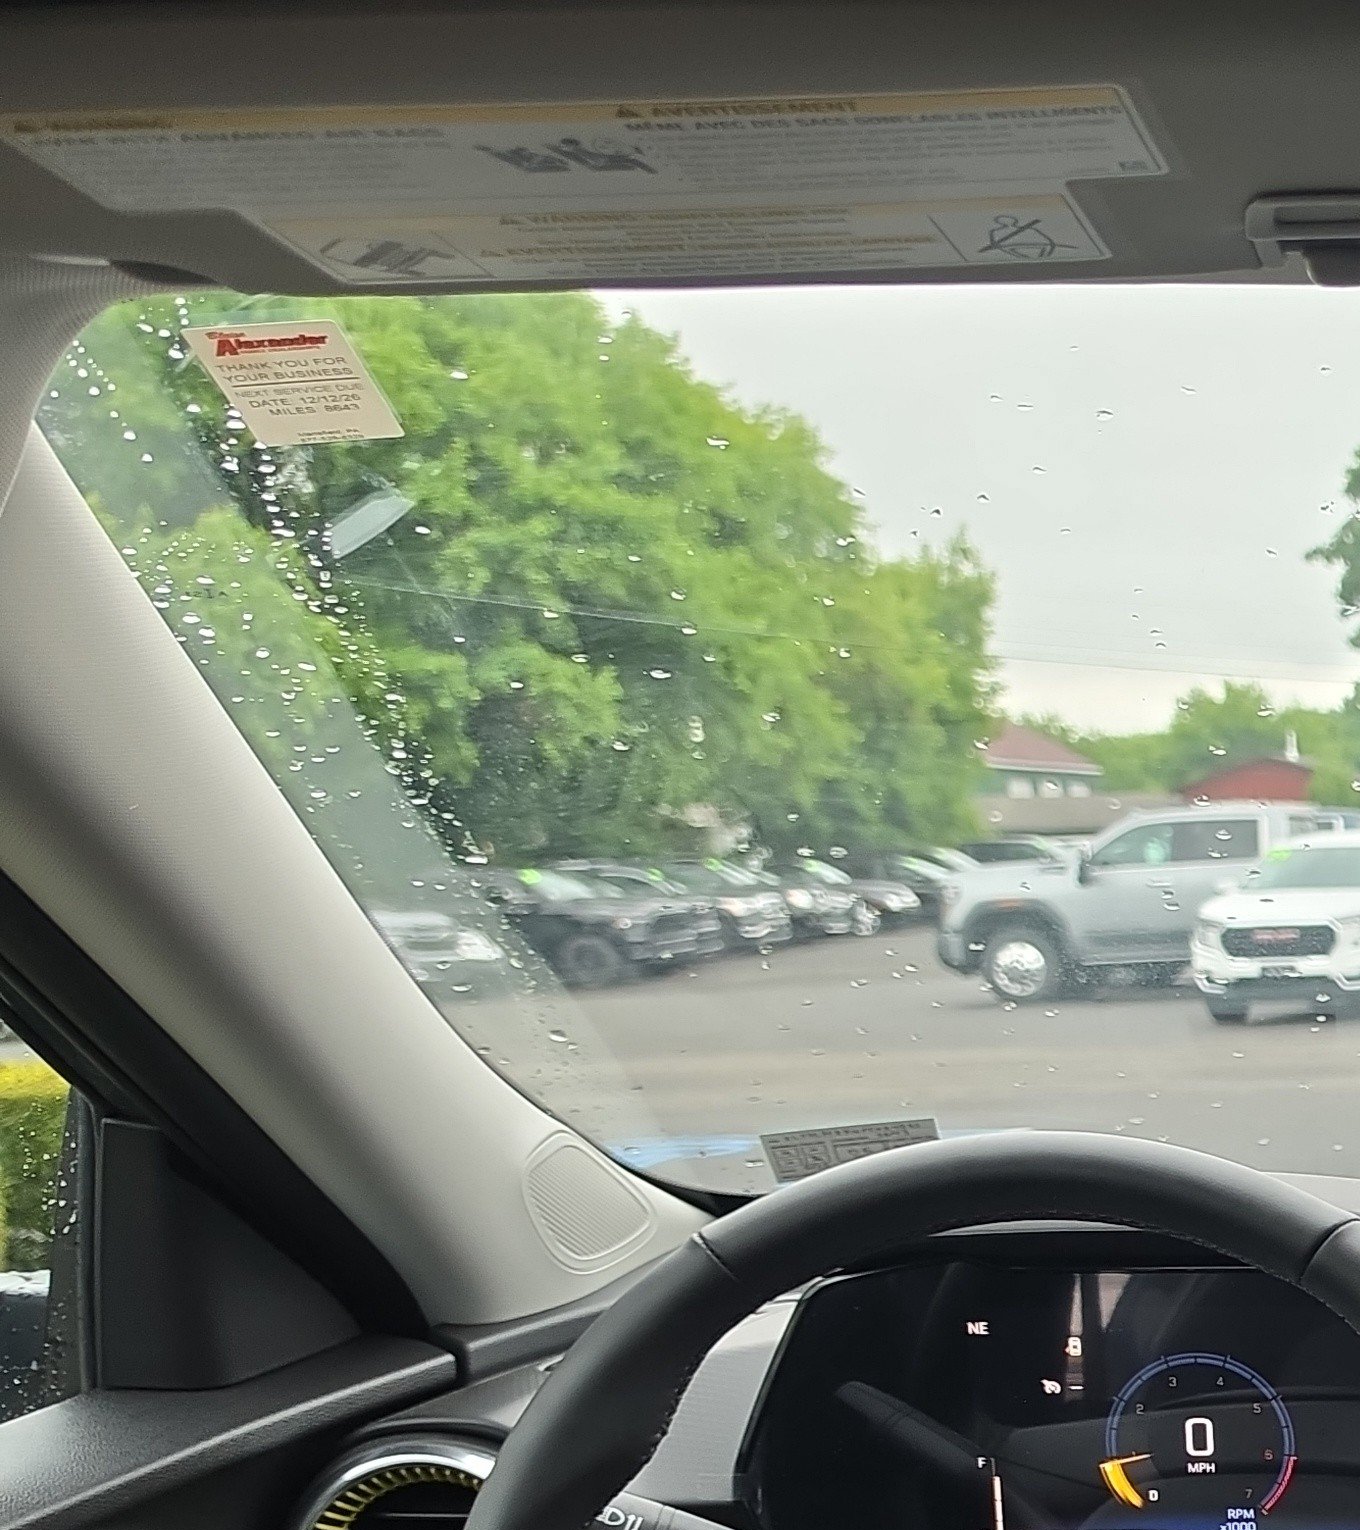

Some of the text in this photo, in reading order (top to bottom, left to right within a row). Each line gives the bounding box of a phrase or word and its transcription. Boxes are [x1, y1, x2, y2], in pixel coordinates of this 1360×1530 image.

[215, 356, 347, 373] THANK YOU FOR
[222, 367, 354, 383] YOUR BUSINESS
[234, 382, 364, 399] NEXT SERVICE DUE
[268, 405, 317, 417] MILES
[966, 1321, 990, 1335] NE
[1168, 1377, 1177, 1387] 3
[1216, 1377, 1224, 1386] 4
[1136, 1404, 1145, 1414] 2
[1253, 1403, 1262, 1413] 5
[1184, 1417, 1214, 1457] 0
[1264, 1450, 1273, 1460] 6
[976, 1457, 987, 1468] F
[1187, 1463, 1216, 1473] MPH
[1245, 1489, 1253, 1499] 7
[1227, 1509, 1255, 1519] RPM
